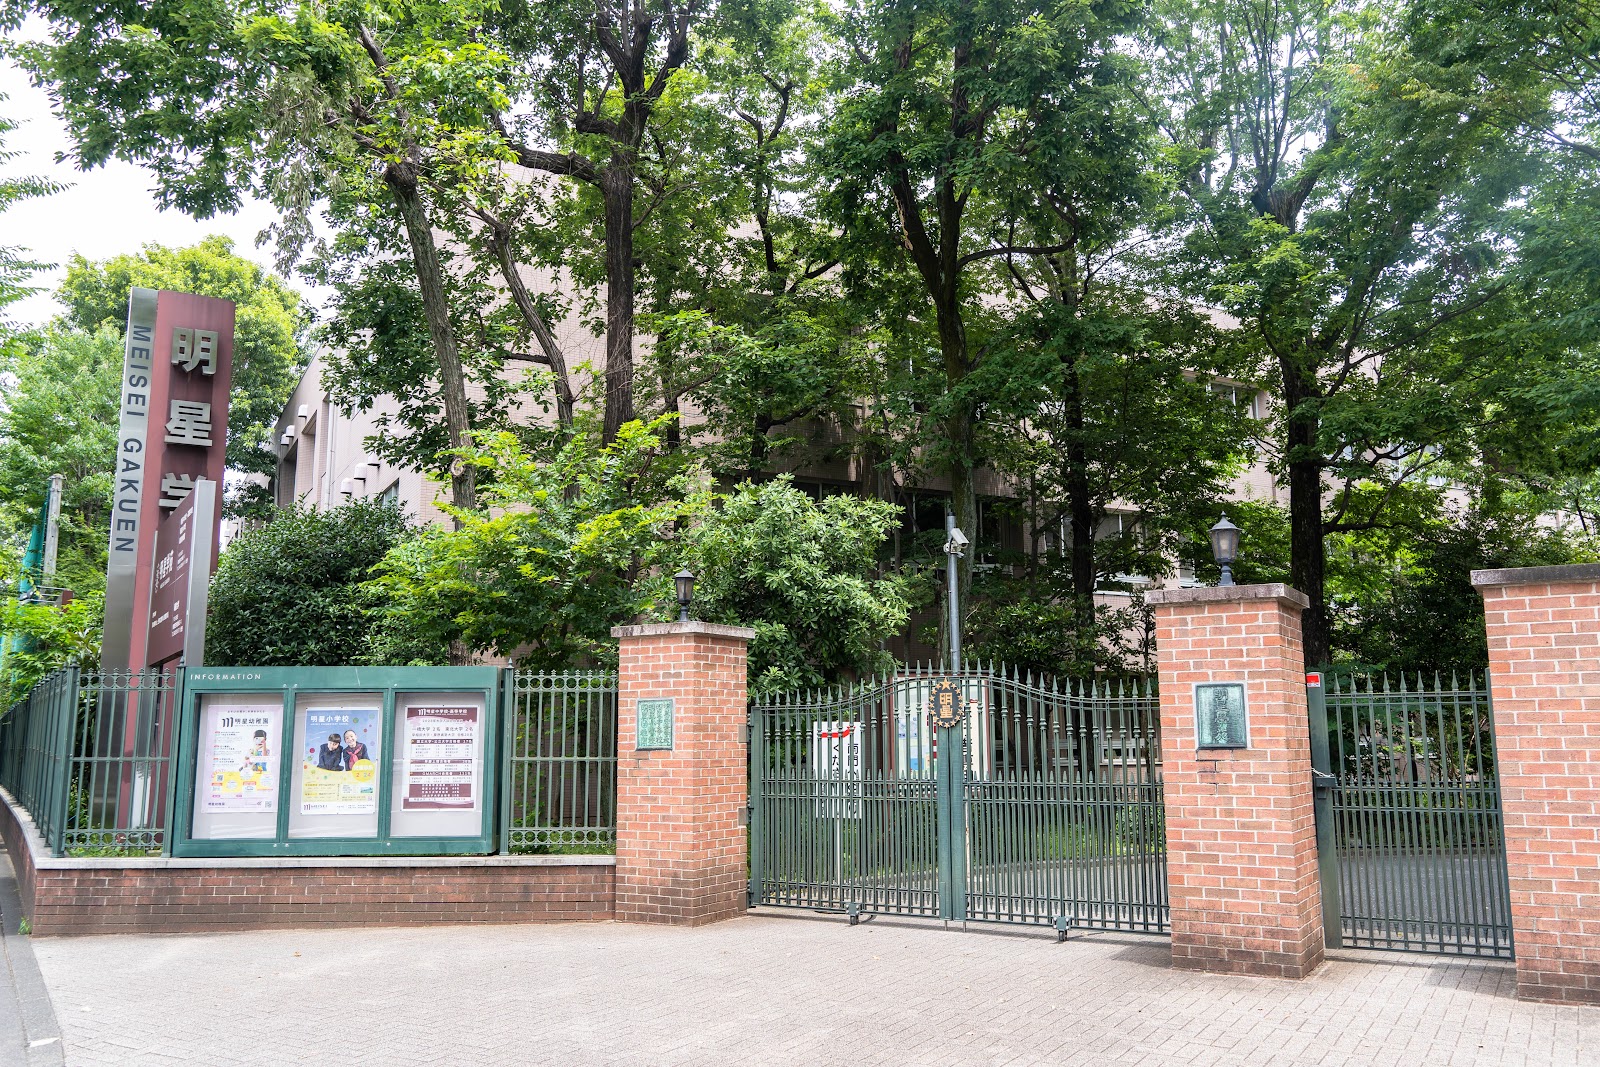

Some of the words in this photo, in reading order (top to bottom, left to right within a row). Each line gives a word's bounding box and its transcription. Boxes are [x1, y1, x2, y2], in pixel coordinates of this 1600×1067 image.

[126, 325, 151, 417] MEISEI
[115, 438, 142, 552] GAKUEN
[310, 715, 349, 723] 明星小学校
